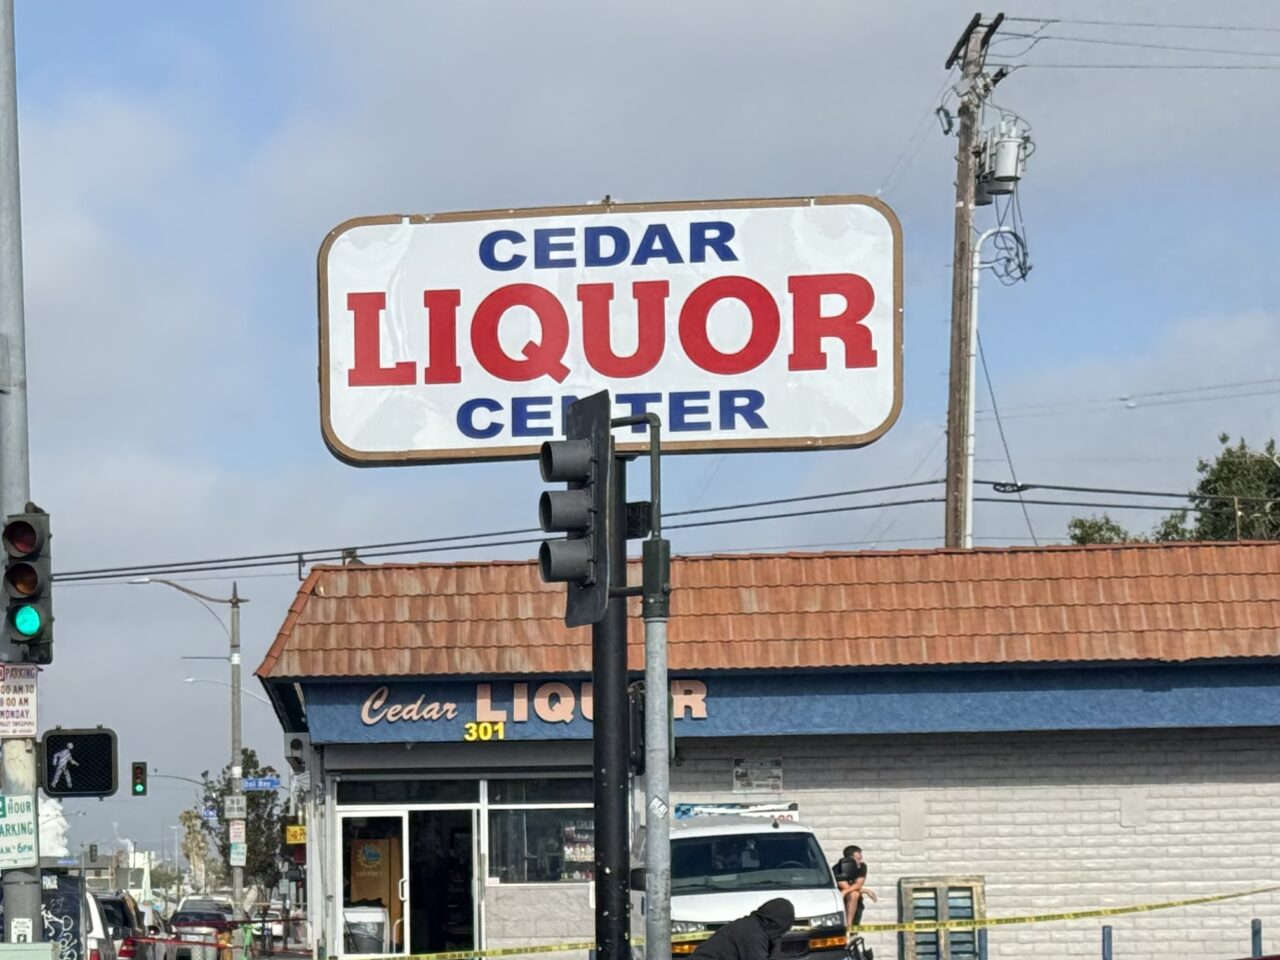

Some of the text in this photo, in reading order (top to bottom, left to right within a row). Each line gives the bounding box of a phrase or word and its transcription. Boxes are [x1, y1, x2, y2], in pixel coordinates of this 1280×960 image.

[479, 221, 738, 271] CEDAR
[347, 273, 878, 387] LIQUOR
[5, 667, 36, 680] PARKING
[12, 684, 24, 695] AM
[25, 684, 35, 695] TO
[18, 696, 29, 706] AM
[361, 679, 708, 726] Cedar LIQR
[0, 709, 30, 719] MONDAY
[463, 721, 505, 742] 301
[7, 801, 32, 814] HOUR
